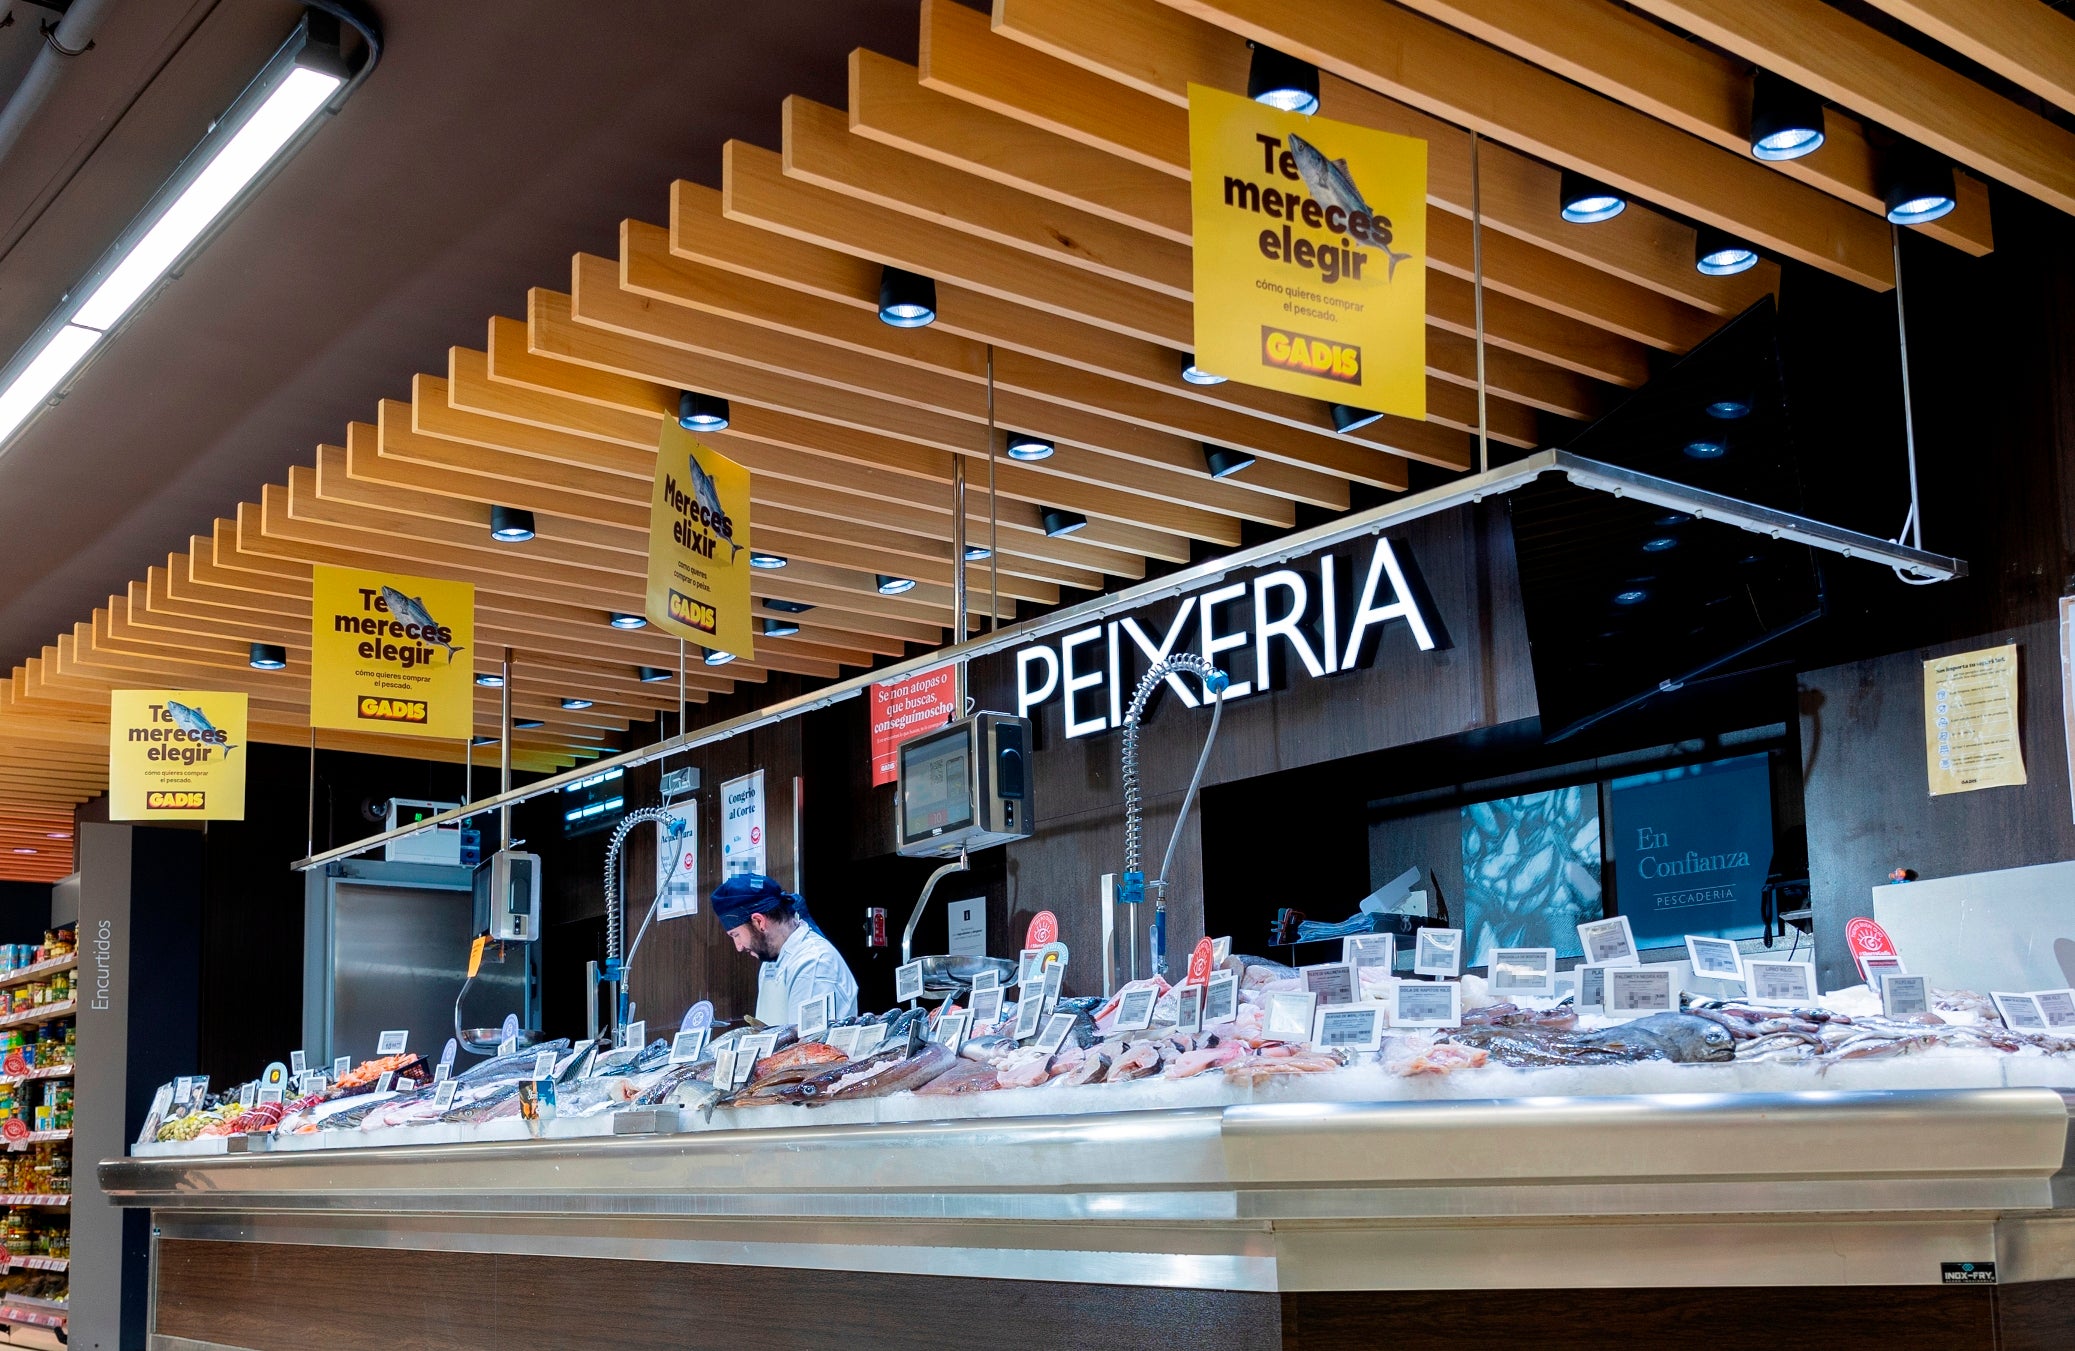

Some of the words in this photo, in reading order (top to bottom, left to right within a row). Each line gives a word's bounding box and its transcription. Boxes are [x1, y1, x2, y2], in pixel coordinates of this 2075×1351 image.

[1256, 132, 1300, 181] Te
[1224, 174, 1394, 246] mereces
[1258, 224, 1367, 284] elegir
[1255, 278, 1283, 296] cómo
[1285, 286, 1321, 304] quieres
[1323, 294, 1364, 315] comprar
[1283, 301, 1292, 312] el
[1294, 306, 1338, 323] pescado.
[1266, 331, 1359, 378] GADIS
[664, 473, 733, 538] Mereces
[673, 519, 717, 560] elixir
[673, 569, 693, 587] comprar
[359, 588, 389, 612] Te
[670, 593, 715, 630] GADIS
[335, 614, 452, 643] mereces
[1017, 536, 1436, 739] PEIXERIA
[358, 638, 434, 668] elegir
[355, 669, 375, 677] cómo
[376, 670, 402, 681] quieres
[402, 674, 431, 683] comprar
[374, 680, 381, 688] el
[381, 681, 412, 690] pescado.
[878, 690, 889, 703] Se
[890, 686, 909, 700] non
[910, 675, 940, 693] atopas
[941, 673, 947, 682] o
[149, 705, 173, 722] Te
[361, 698, 426, 721] GADIS
[874, 701, 954, 734] conseguímoscho
[887, 702, 904, 717] que
[905, 692, 937, 710] buscas,
[128, 728, 228, 743] mereces
[147, 743, 212, 766] elegir
[149, 792, 204, 808] GADIS
[728, 786, 756, 804] Congrio
[728, 808, 736, 820] al
[737, 804, 756, 817] Corte
[1636, 827, 1670, 851] En
[1638, 850, 1751, 881] Confianza
[92, 919, 111, 1010] Encurtidos
[1944, 1272, 1992, 1280] INOX-FRY
